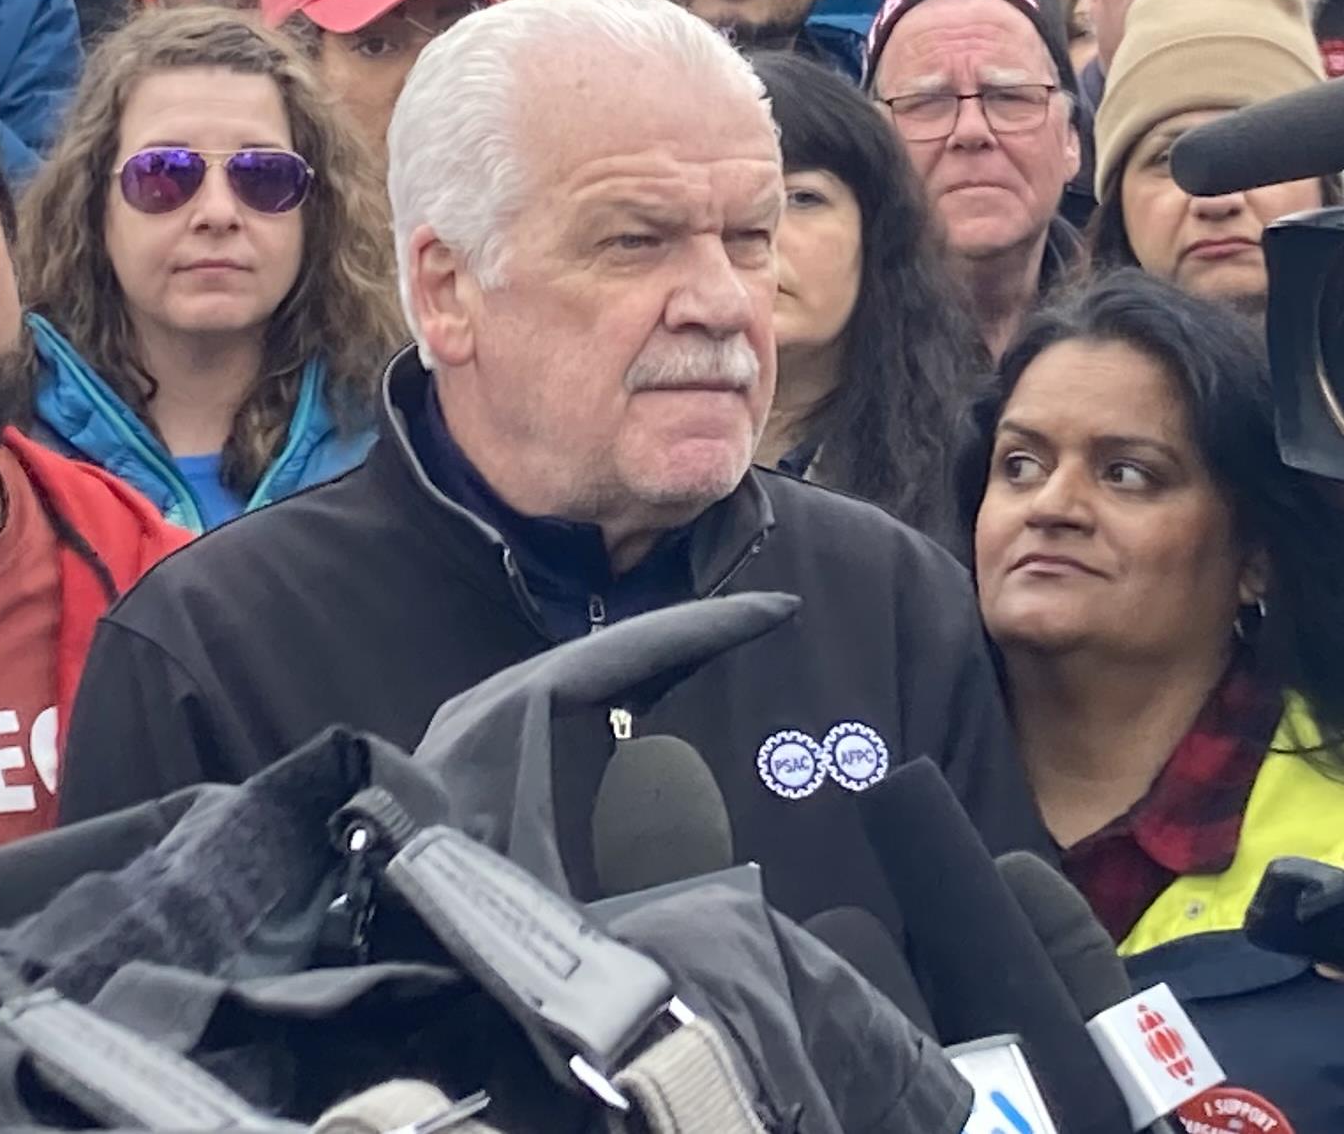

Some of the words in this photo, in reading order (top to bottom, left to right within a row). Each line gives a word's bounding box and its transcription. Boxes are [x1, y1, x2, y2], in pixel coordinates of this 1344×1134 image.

[774, 755, 811, 774] PSAC
[841, 749, 875, 766] AFPC
[1214, 1098, 1278, 1132] SUPPORT
